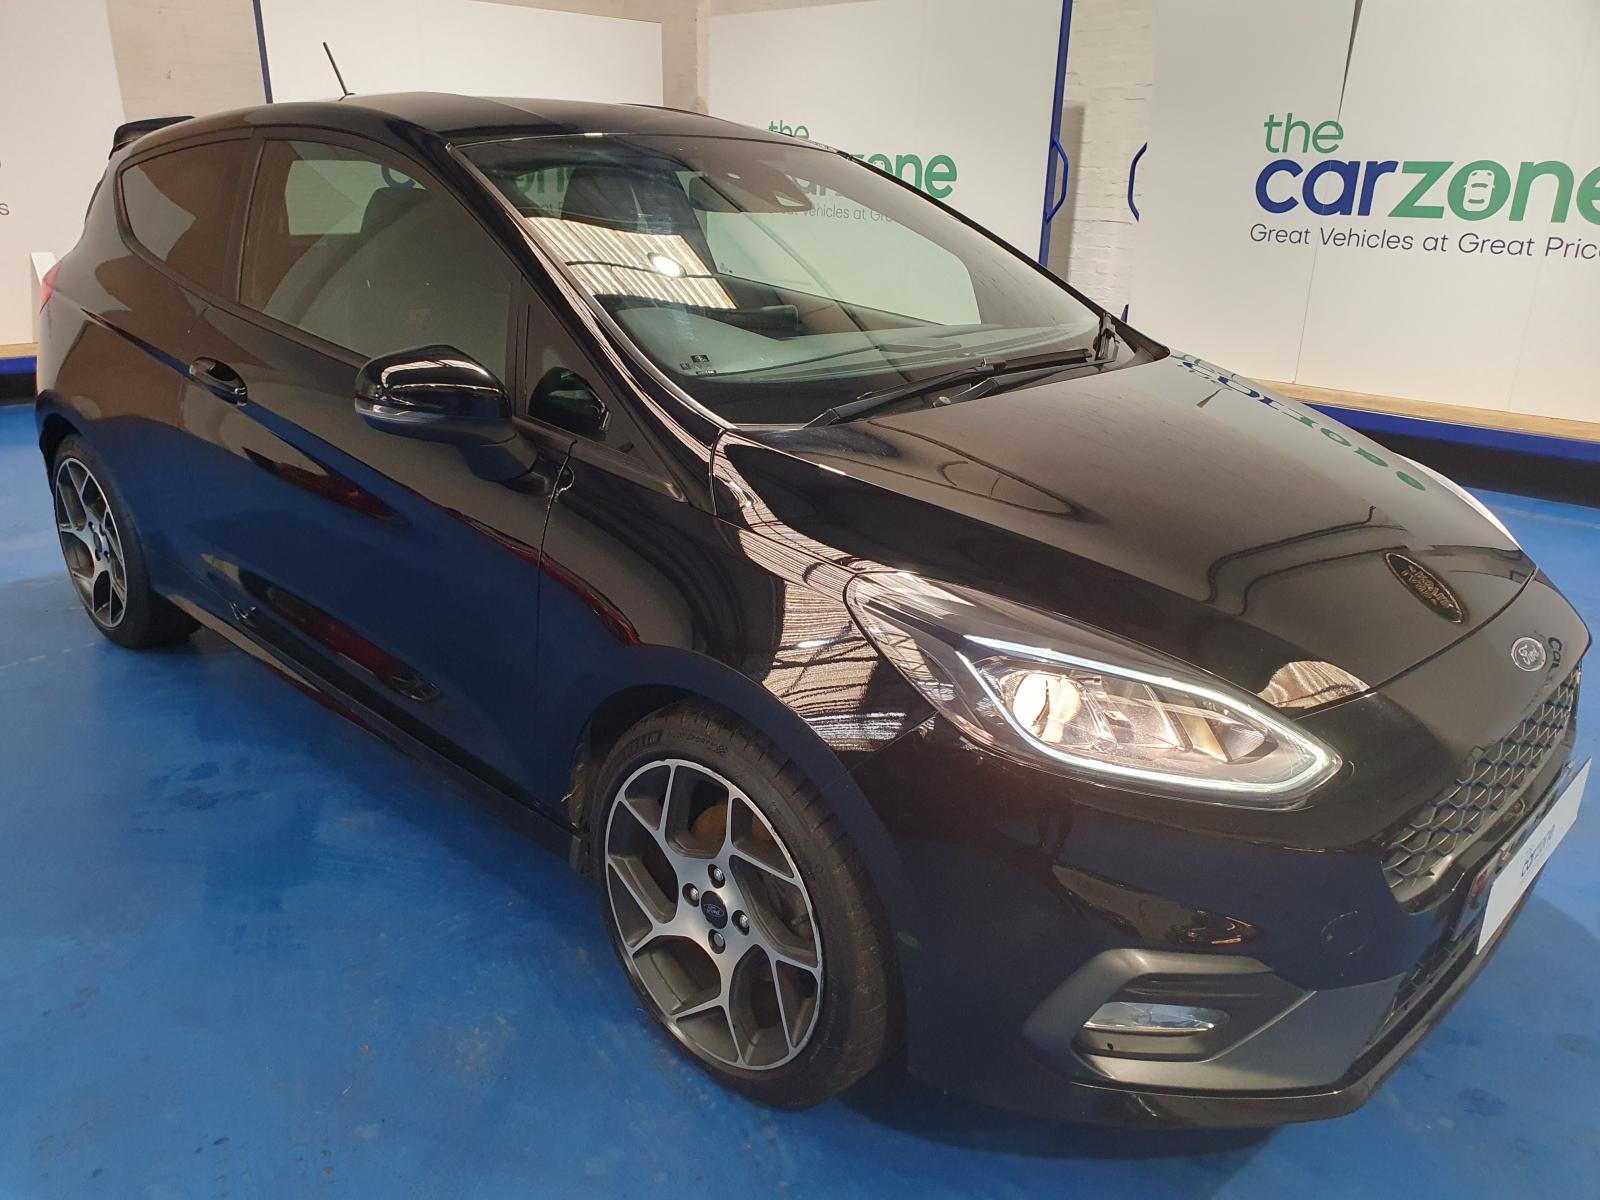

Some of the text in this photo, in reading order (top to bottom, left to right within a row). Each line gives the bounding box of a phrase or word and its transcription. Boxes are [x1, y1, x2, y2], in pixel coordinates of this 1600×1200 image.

[1263, 112, 1345, 154] the
[849, 153, 958, 199] one
[1250, 223, 1600, 260] Great Vehicles at Great Pric
